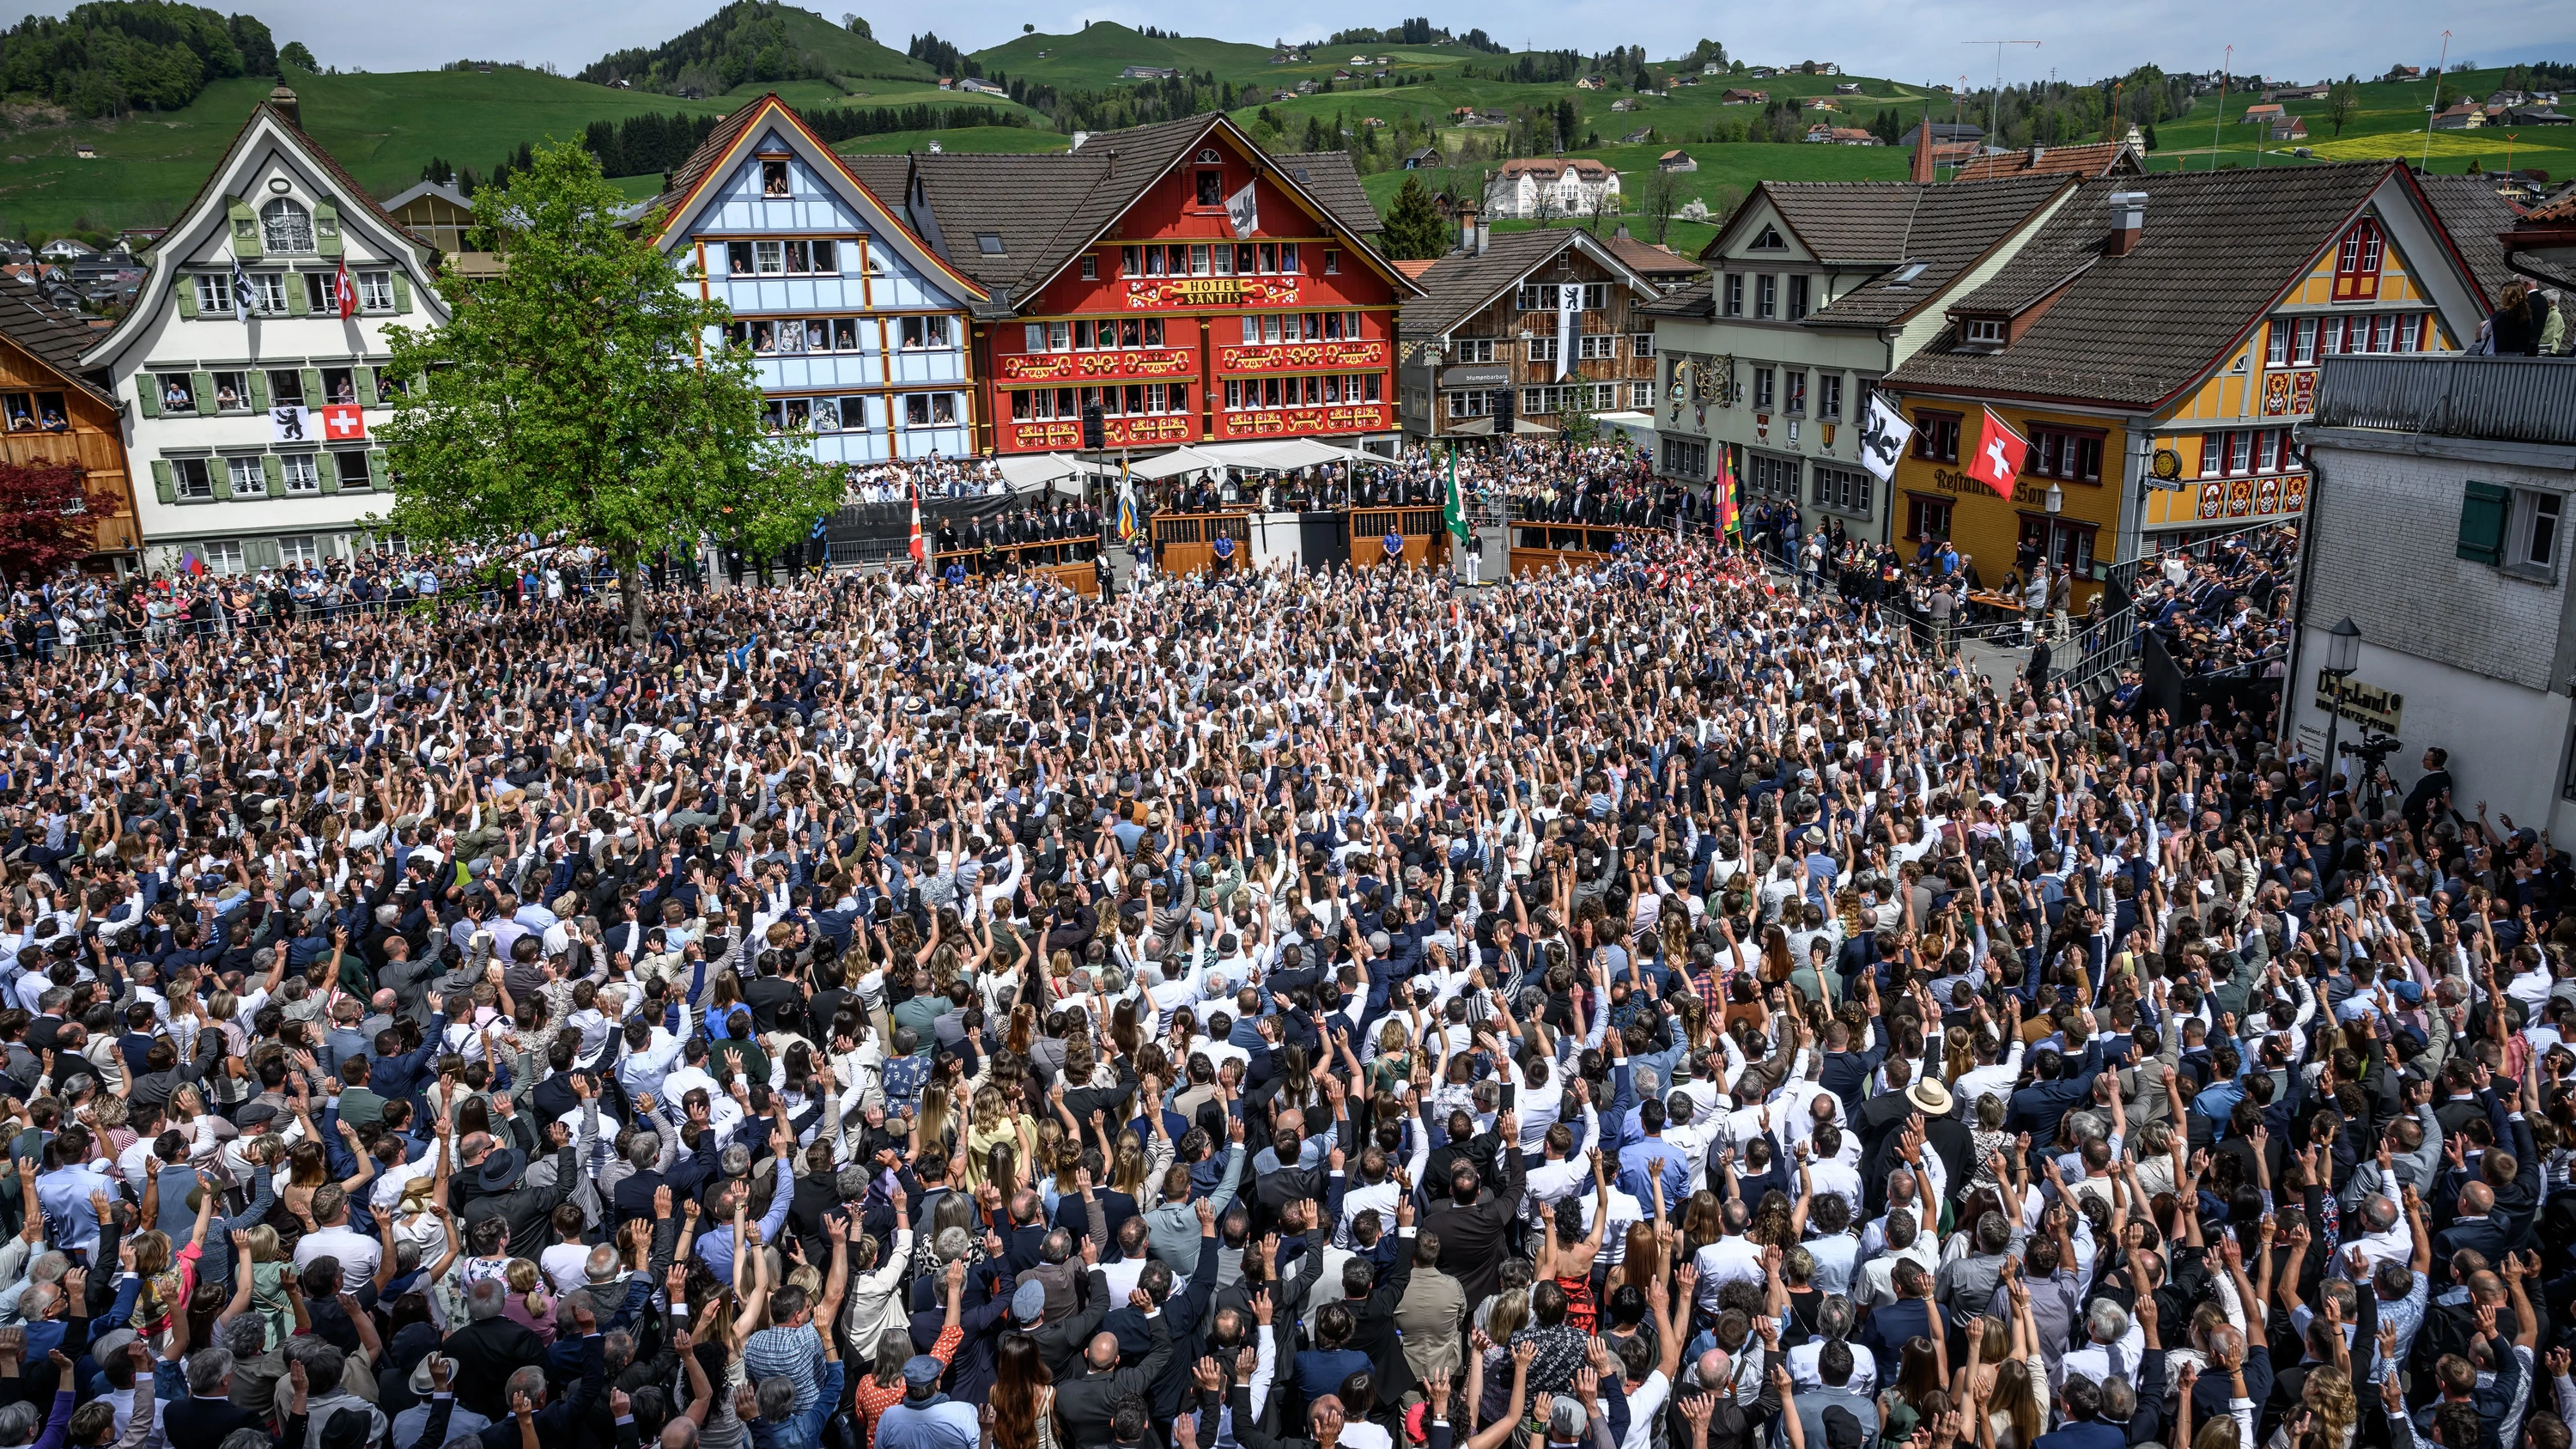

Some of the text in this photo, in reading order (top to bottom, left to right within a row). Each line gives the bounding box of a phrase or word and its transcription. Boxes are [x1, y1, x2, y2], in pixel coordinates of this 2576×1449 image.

[1190, 281, 1240, 291] HOTEL
[1187, 293, 1241, 304] SÄNTIS
[2147, 477, 2178, 490] Restaurant
